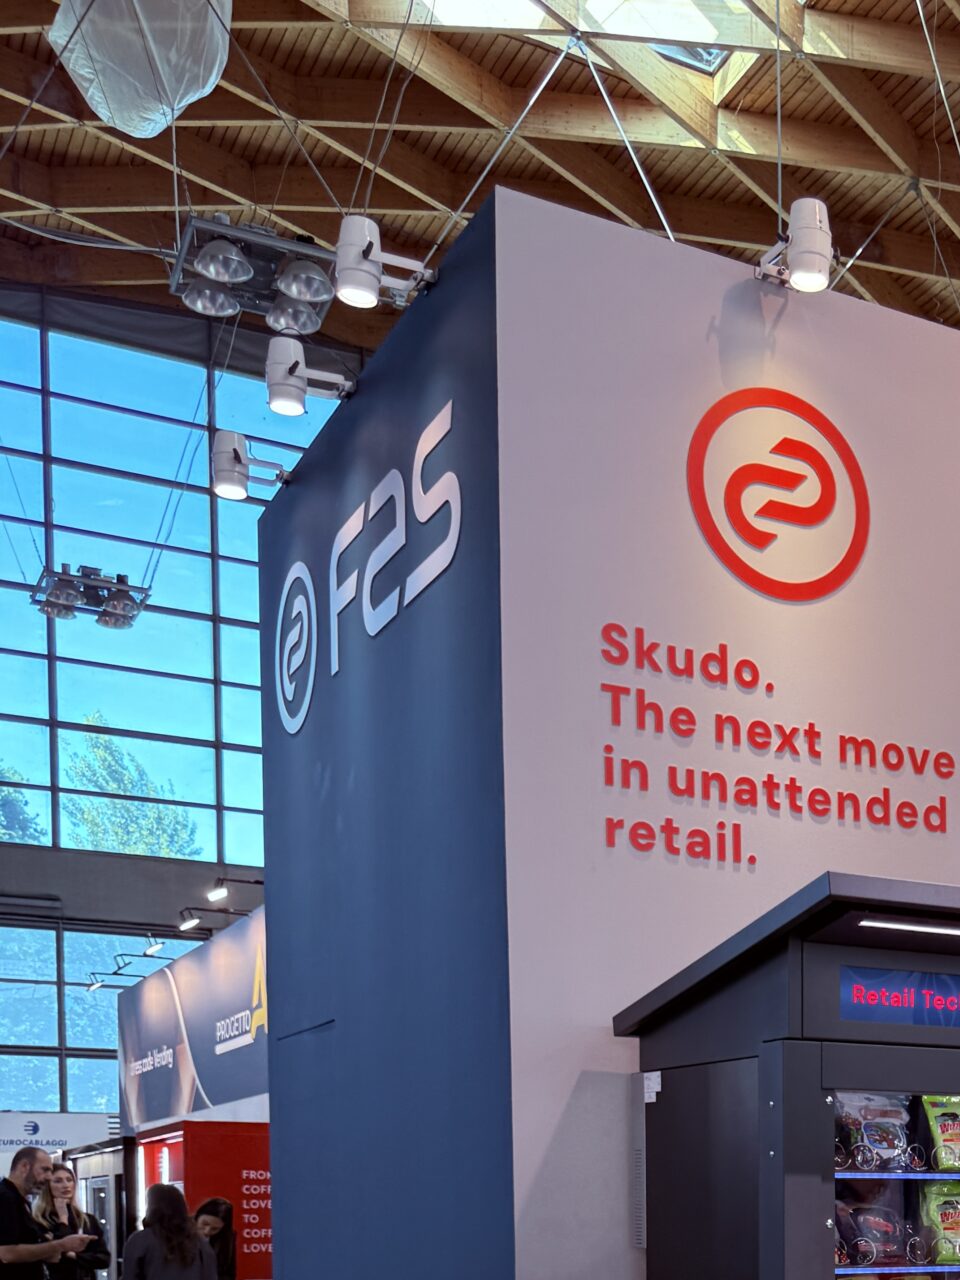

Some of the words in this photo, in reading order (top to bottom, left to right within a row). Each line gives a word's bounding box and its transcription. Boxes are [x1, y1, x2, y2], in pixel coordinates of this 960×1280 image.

[601, 622, 775, 694] Skudo.
[601, 682, 697, 738] The
[714, 712, 822, 760] next
[838, 734, 956, 780] move
[602, 744, 650, 792] in
[667, 763, 948, 834] unattended
[604, 816, 758, 866] retail.
[851, 983, 915, 1009] Retail
[215, 1009, 251, 1042] PROGETTO
[243, 1214, 259, 1224] TO
